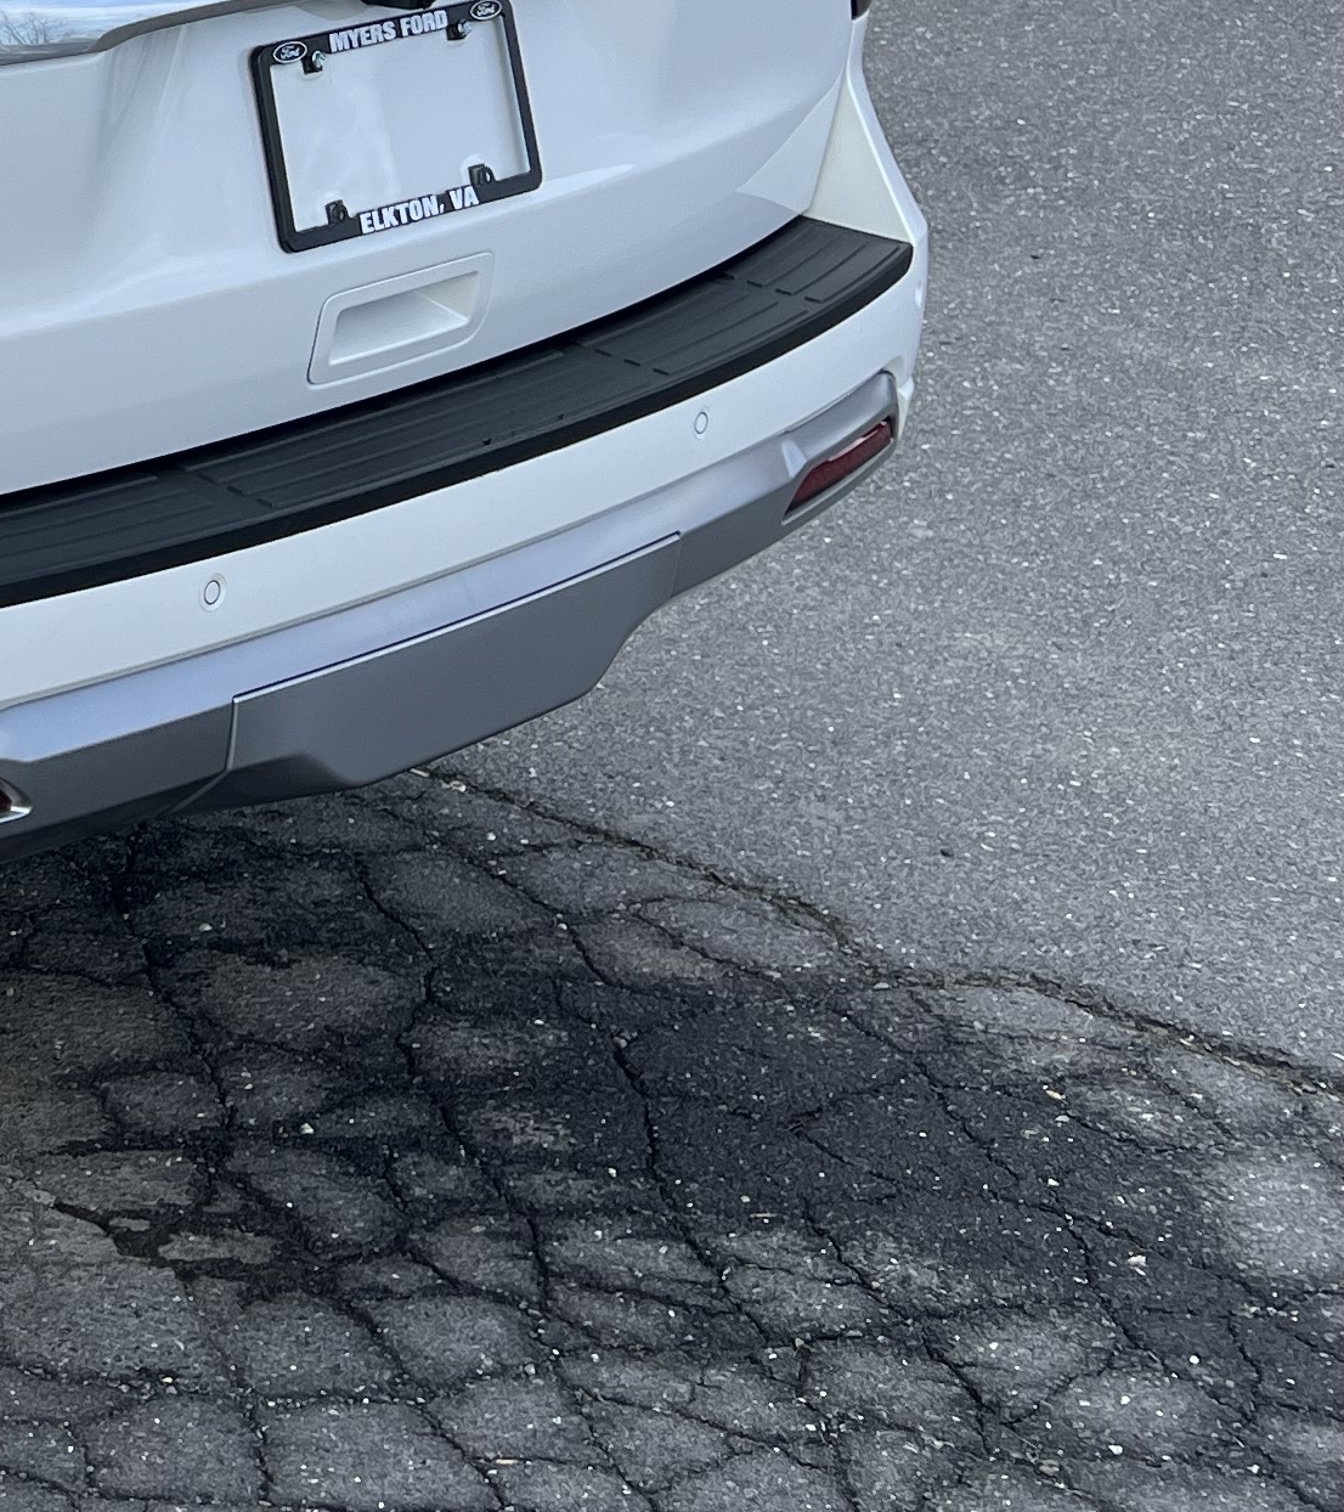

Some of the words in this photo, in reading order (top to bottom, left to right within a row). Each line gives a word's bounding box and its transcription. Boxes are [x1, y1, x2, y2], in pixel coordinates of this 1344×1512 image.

[328, 20, 398, 53] MYERS
[400, 9, 449, 38] FORD
[359, 195, 445, 235] ELKTON,
[449, 185, 480, 210] VA
